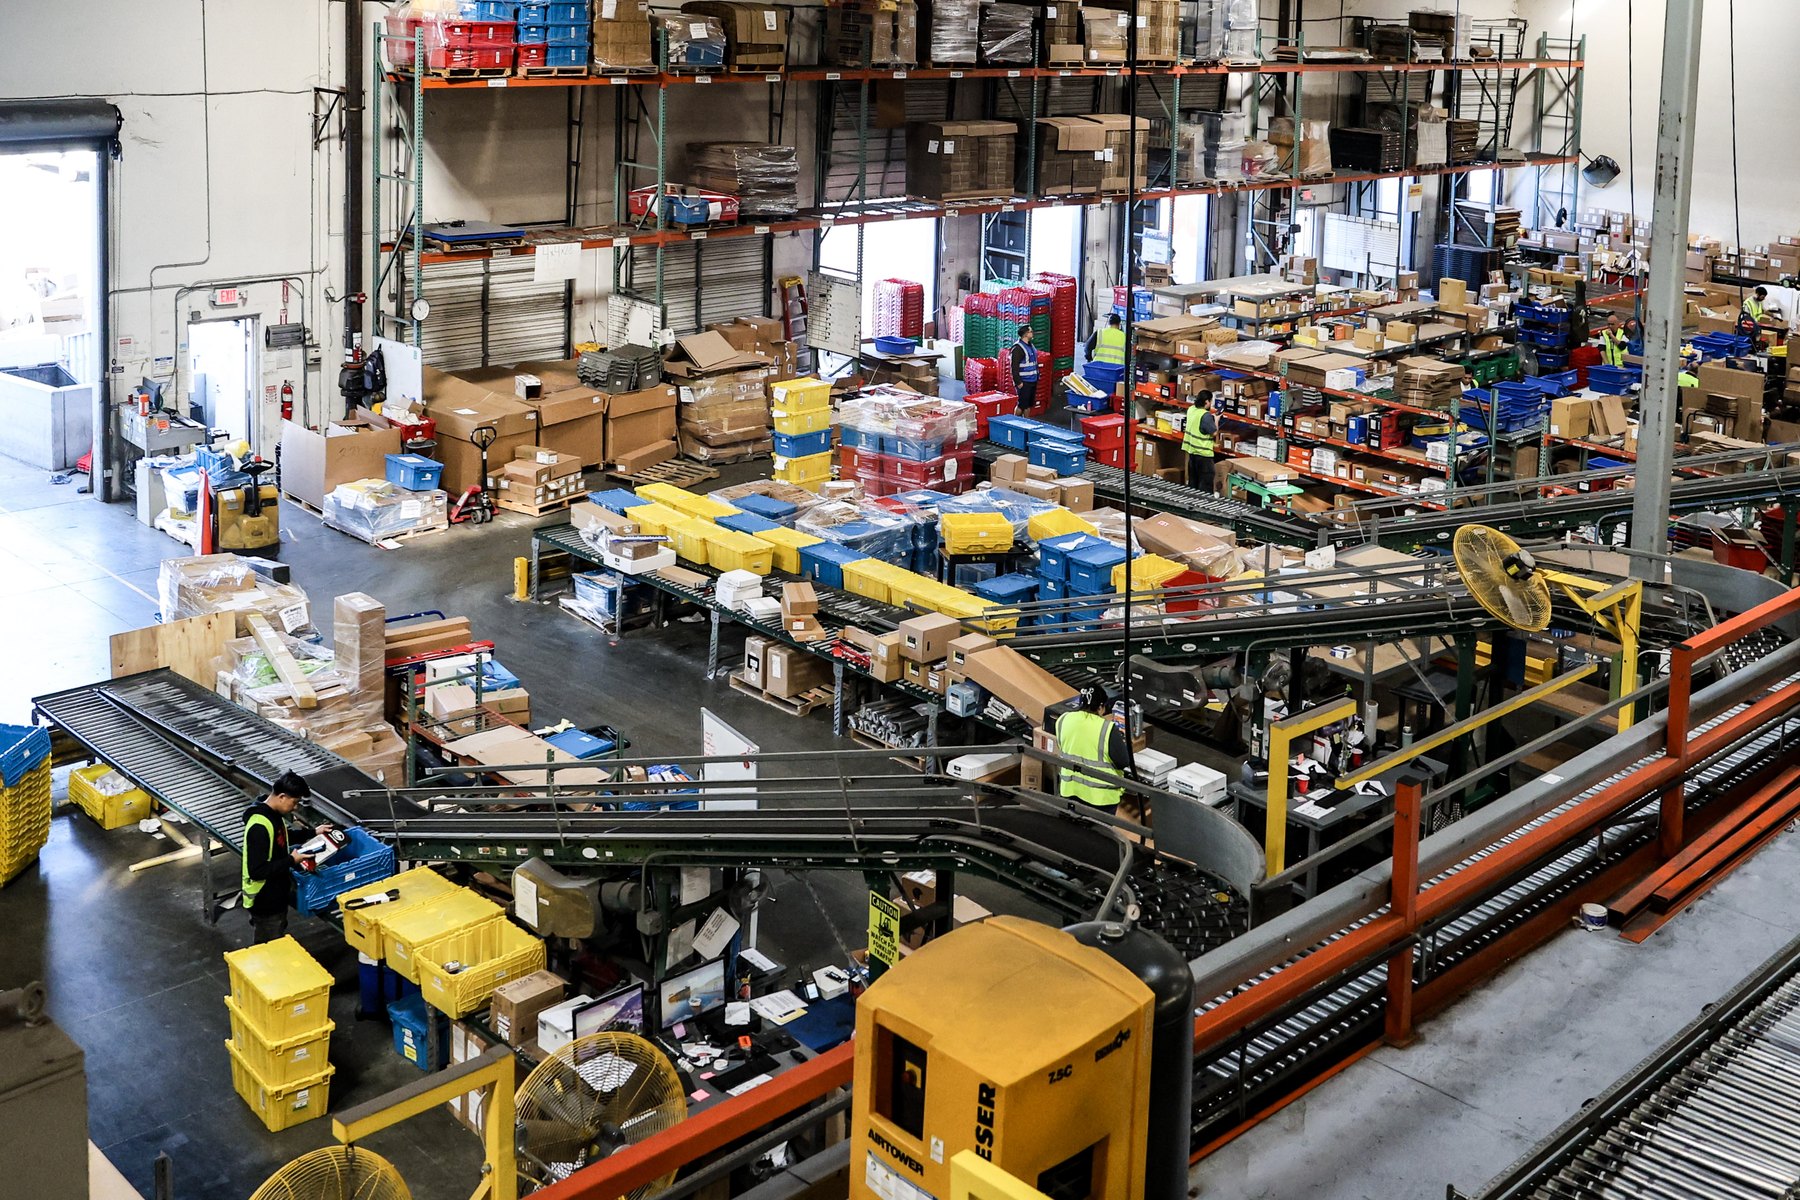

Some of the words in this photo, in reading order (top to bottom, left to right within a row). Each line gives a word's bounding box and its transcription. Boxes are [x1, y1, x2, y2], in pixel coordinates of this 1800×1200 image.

[220, 289, 237, 303] EXIT
[872, 896, 898, 920] CAUTION
[871, 931, 887, 946] WATCH
[887, 941, 897, 952] FOR
[873, 939, 895, 958] FORKLIFT
[874, 947, 893, 965] TRAFFIC
[1048, 1063, 1073, 1085] 7.5C
[868, 1128, 924, 1176] AIRTOWER
